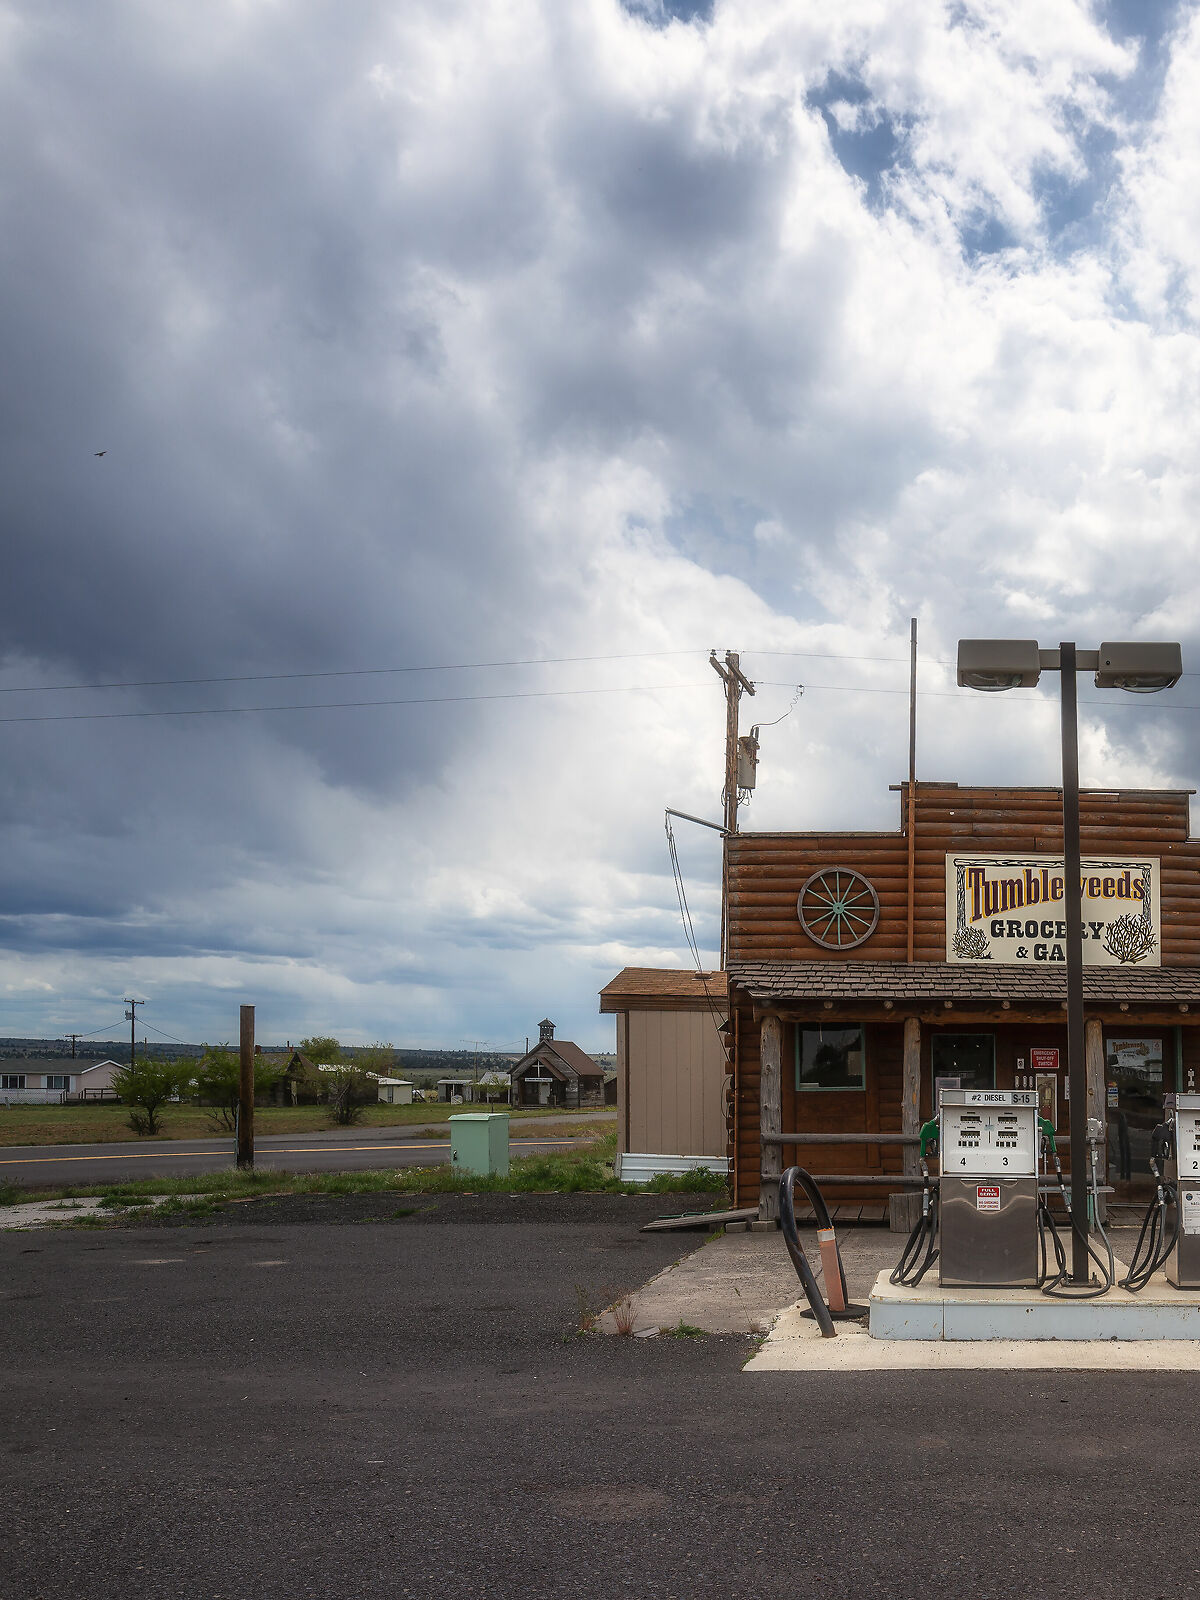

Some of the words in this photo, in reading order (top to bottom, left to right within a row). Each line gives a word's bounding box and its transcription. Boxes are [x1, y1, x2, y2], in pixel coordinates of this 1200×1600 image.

[1016, 946, 1029, 959] &
[1033, 943, 1066, 962] GA
[971, 1094, 982, 1102] #2
[984, 1094, 1006, 1102] DIESEL
[1013, 1094, 1030, 1104] S-15
[960, 1157, 967, 1166] 4
[1002, 1156, 1009, 1166] 3
[1192, 1160, 1199, 1170] 2
